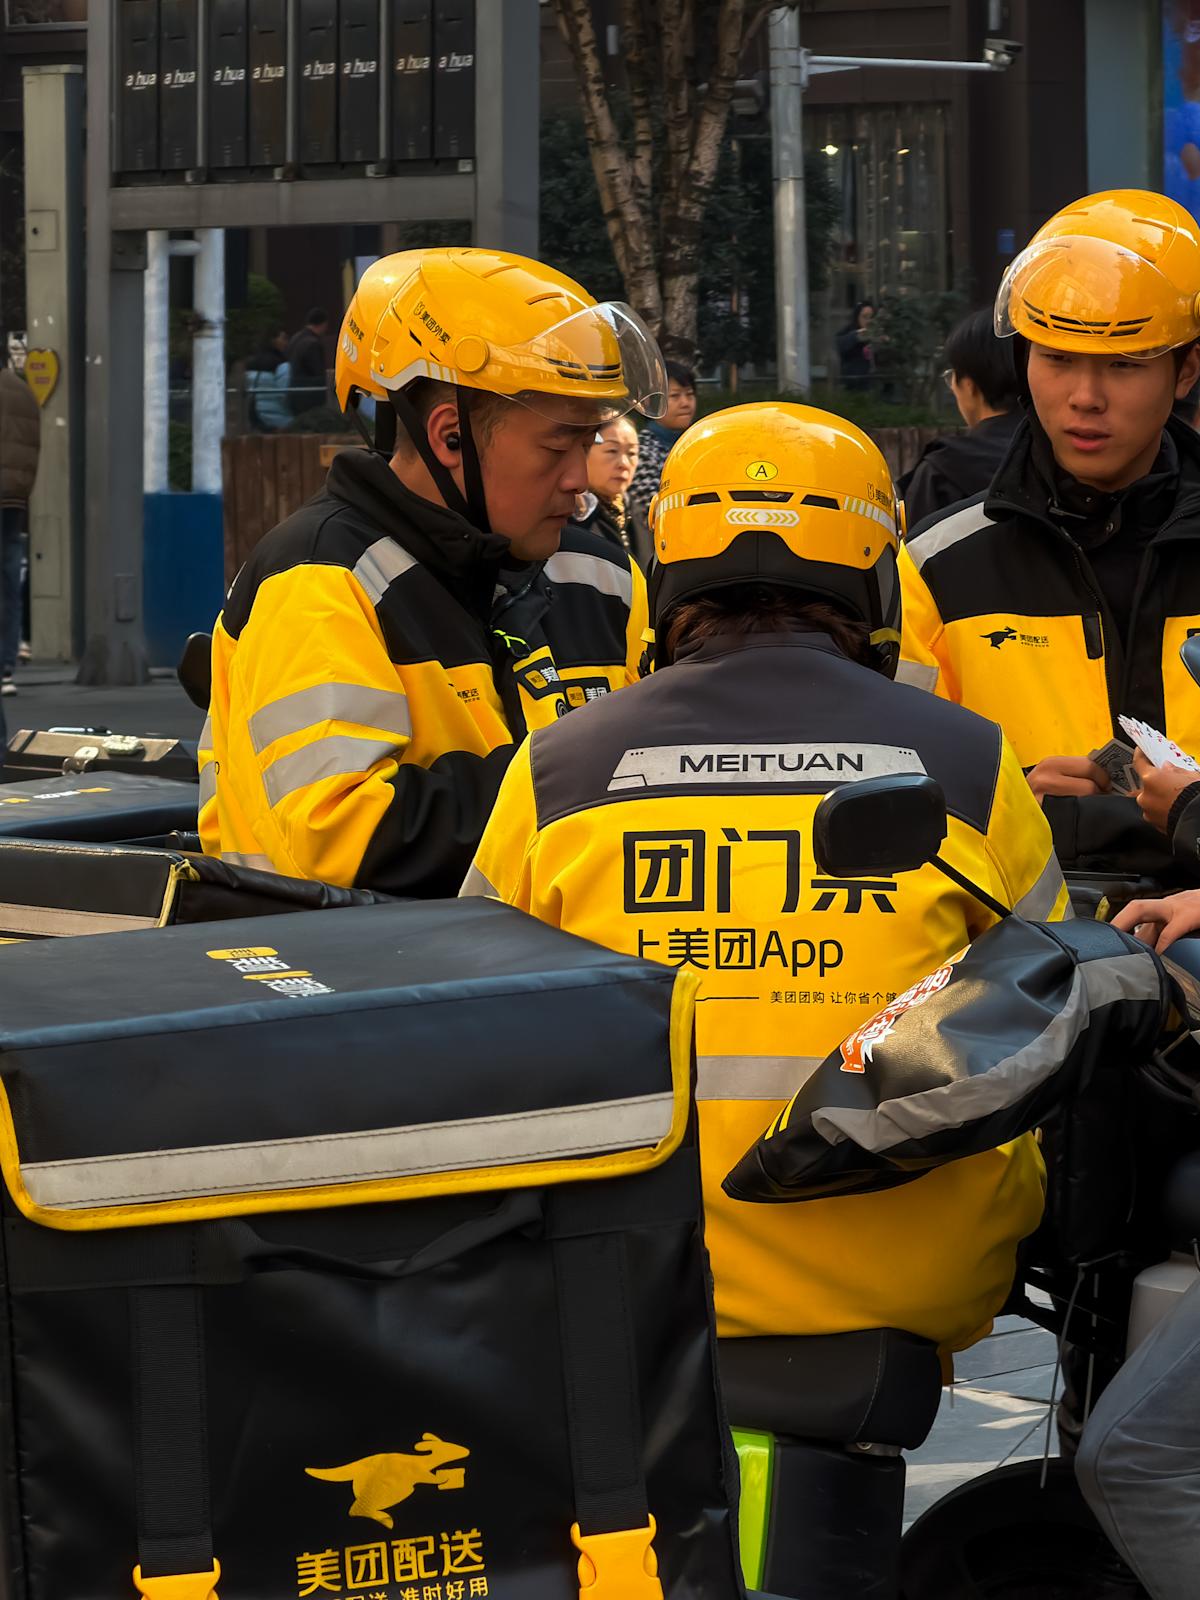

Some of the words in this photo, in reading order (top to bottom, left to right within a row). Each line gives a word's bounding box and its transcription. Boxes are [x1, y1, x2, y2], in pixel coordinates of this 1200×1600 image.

[420, 310, 451, 345] 美团外卖
[755, 464, 768, 478] A
[680, 753, 863, 773] MEITUAN
[638, 927, 844, 978] 上美团App
[770, 991, 826, 1004] 美团团购
[296, 1528, 486, 1598] 美团配送
